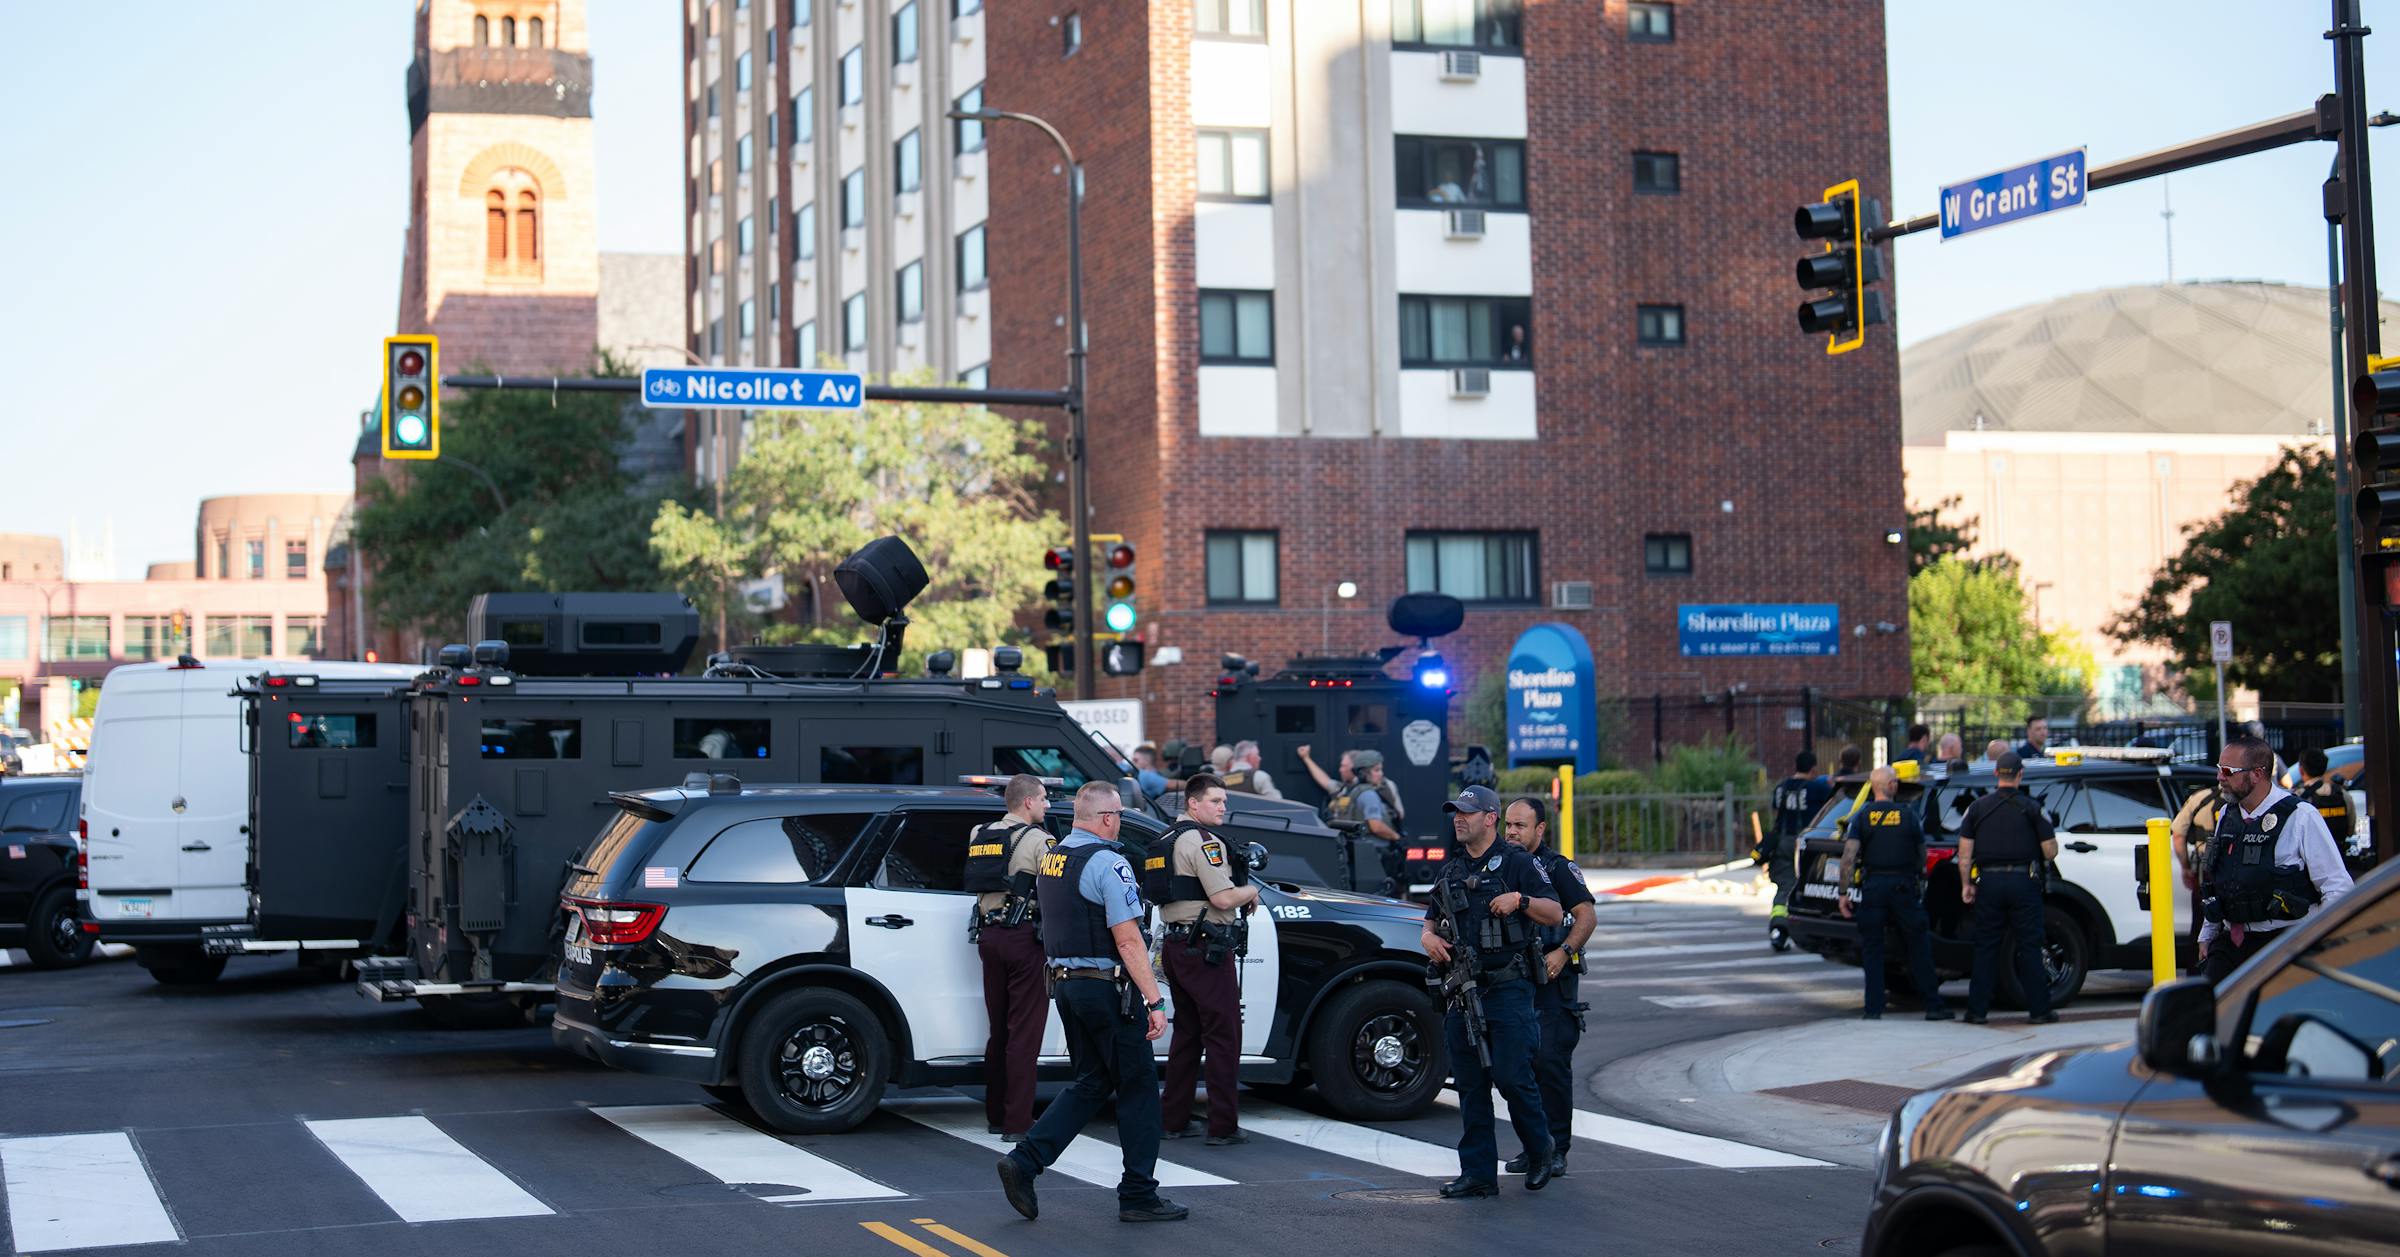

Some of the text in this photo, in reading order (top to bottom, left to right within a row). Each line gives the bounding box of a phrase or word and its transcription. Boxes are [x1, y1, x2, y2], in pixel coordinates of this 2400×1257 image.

[1945, 162, 2078, 229] W Grant St
[686, 375, 856, 403] Nicollet Av
[1688, 611, 1831, 633] Shoreline Plaza
[1509, 667, 1576, 689] Shoreline
[1523, 689, 1563, 709] Plaza
[1075, 708, 1130, 725] CLOSED
[1775, 785, 1808, 811] FRE
[968, 843, 1003, 857] STATE PATROL
[1040, 852, 1067, 877] POLICE
[1803, 882, 1863, 903] MINNEAOLI
[1272, 904, 1312, 919] 182
